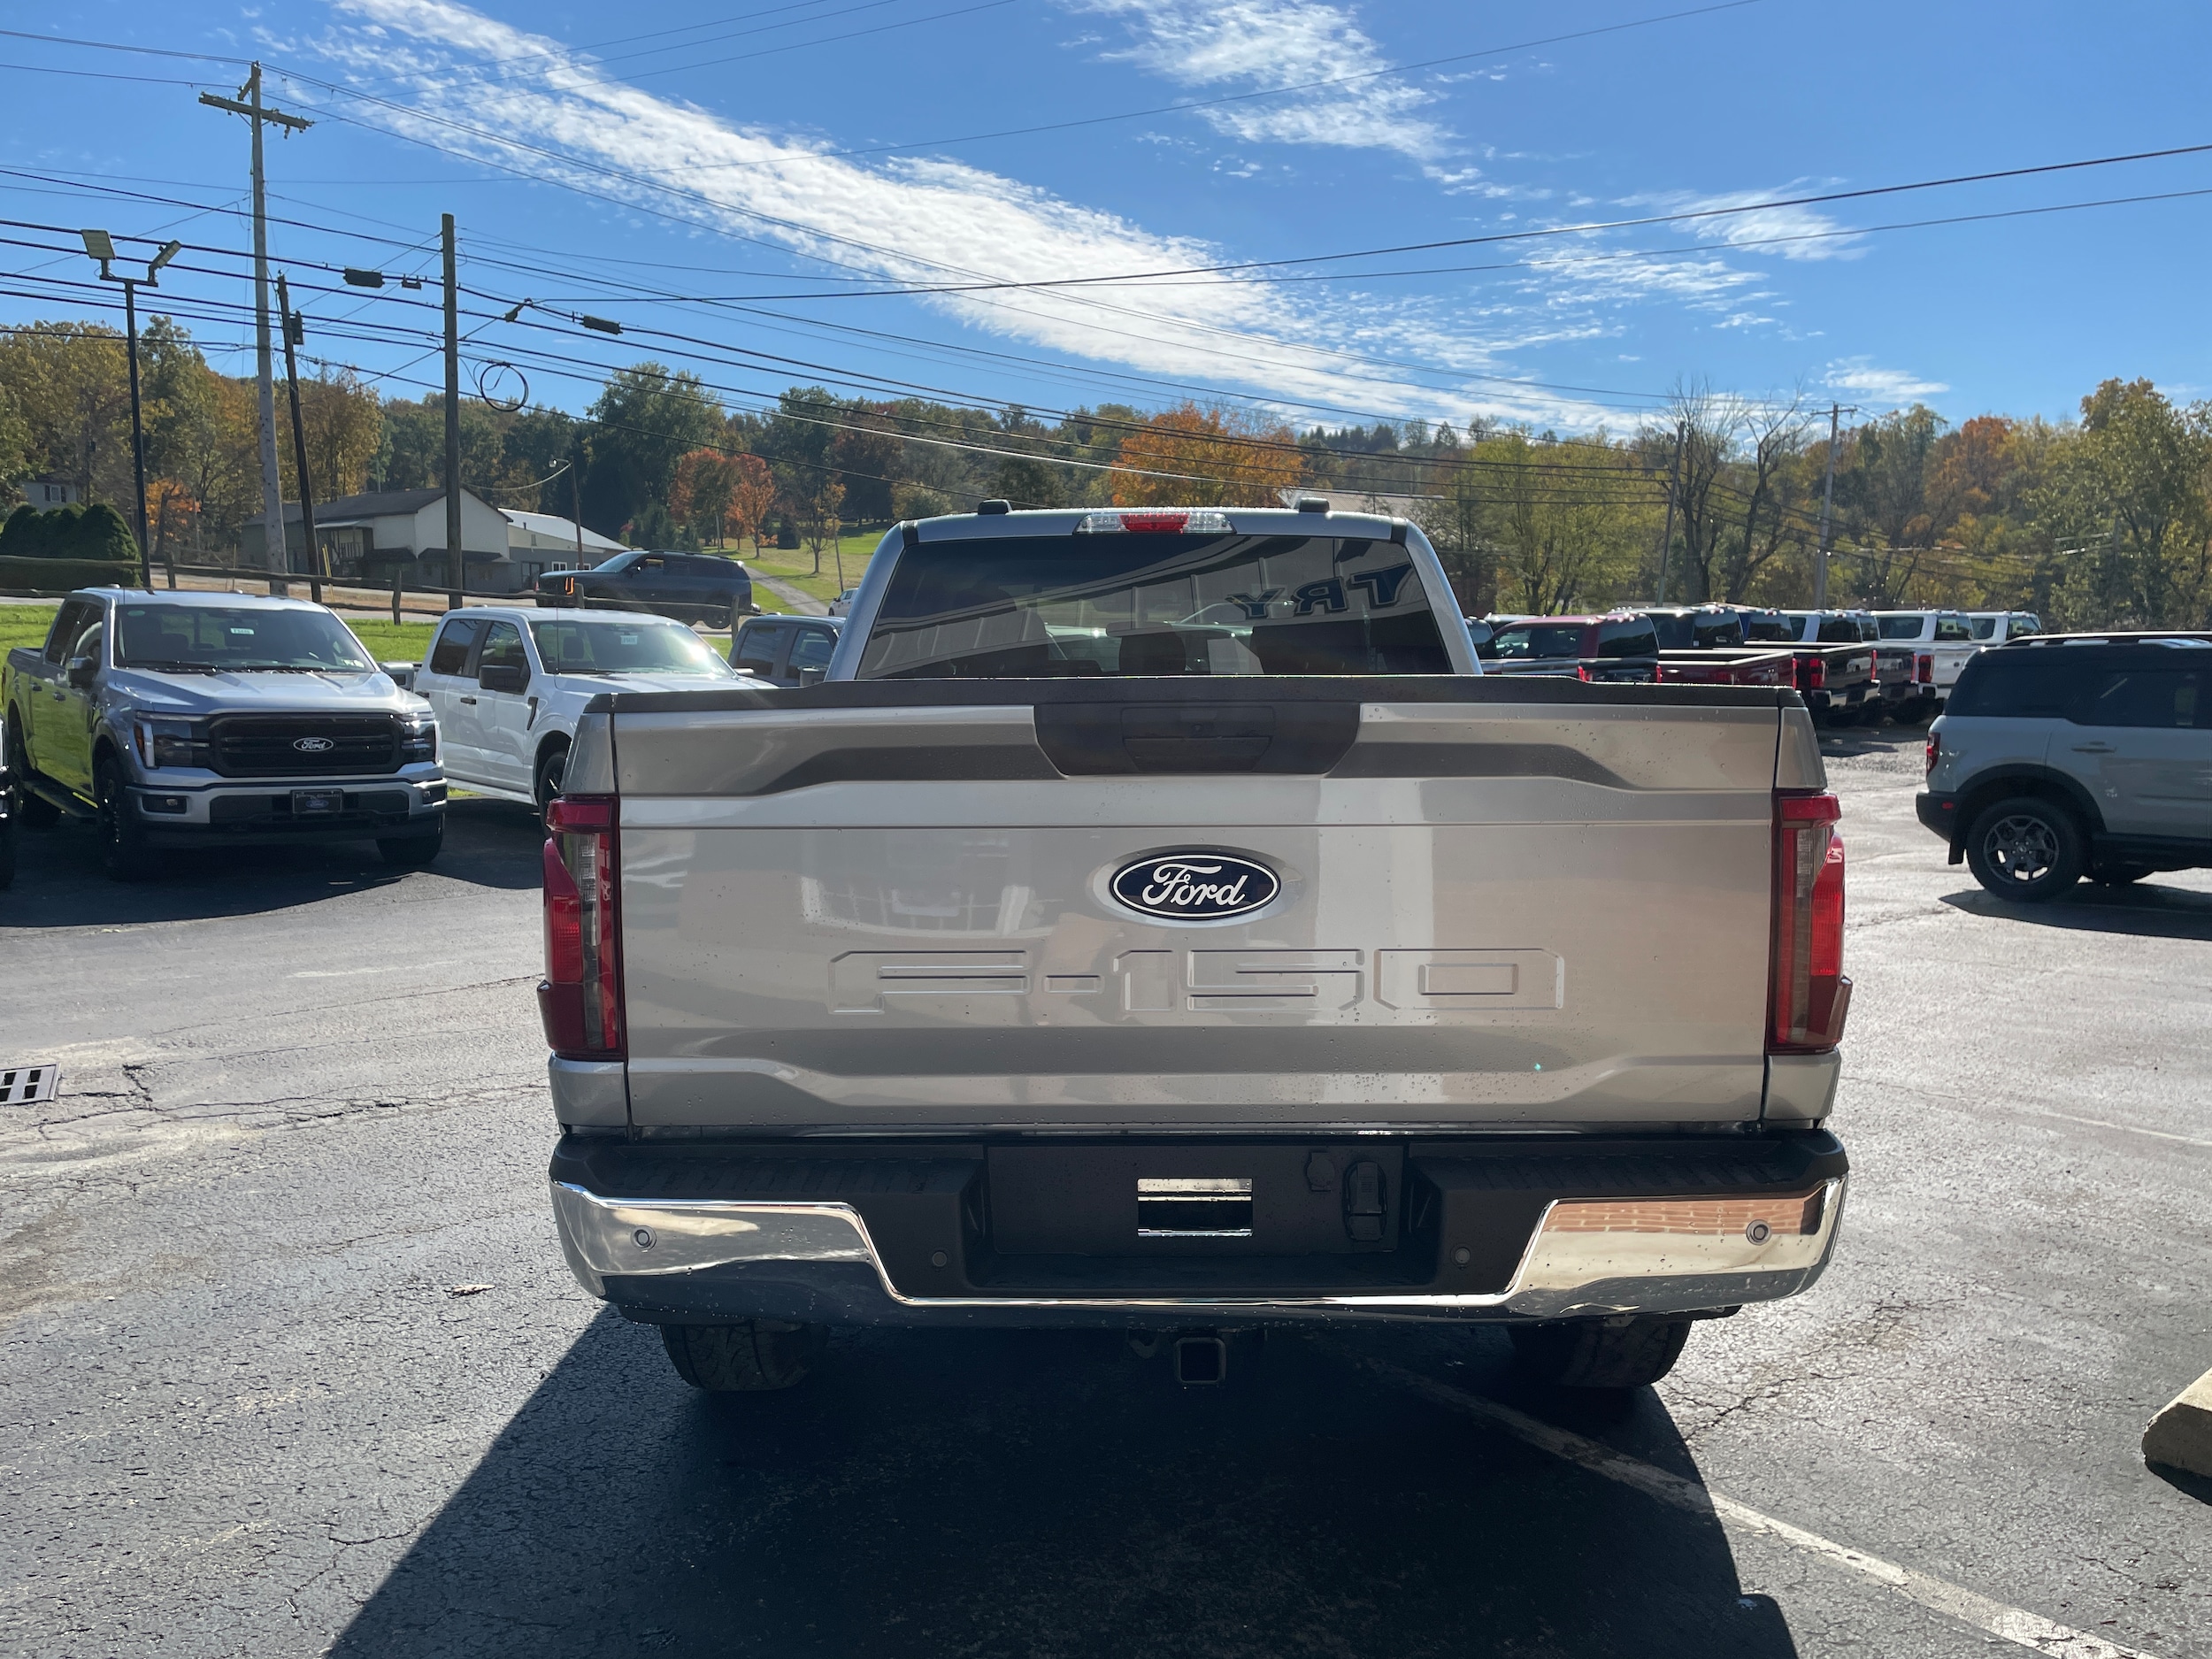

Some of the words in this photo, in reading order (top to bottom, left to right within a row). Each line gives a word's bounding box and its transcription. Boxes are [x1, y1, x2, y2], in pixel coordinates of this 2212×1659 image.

[301, 739, 326, 749] Ford
[1141, 863, 1248, 906] Ford
[828, 948, 1565, 1015] F-150
